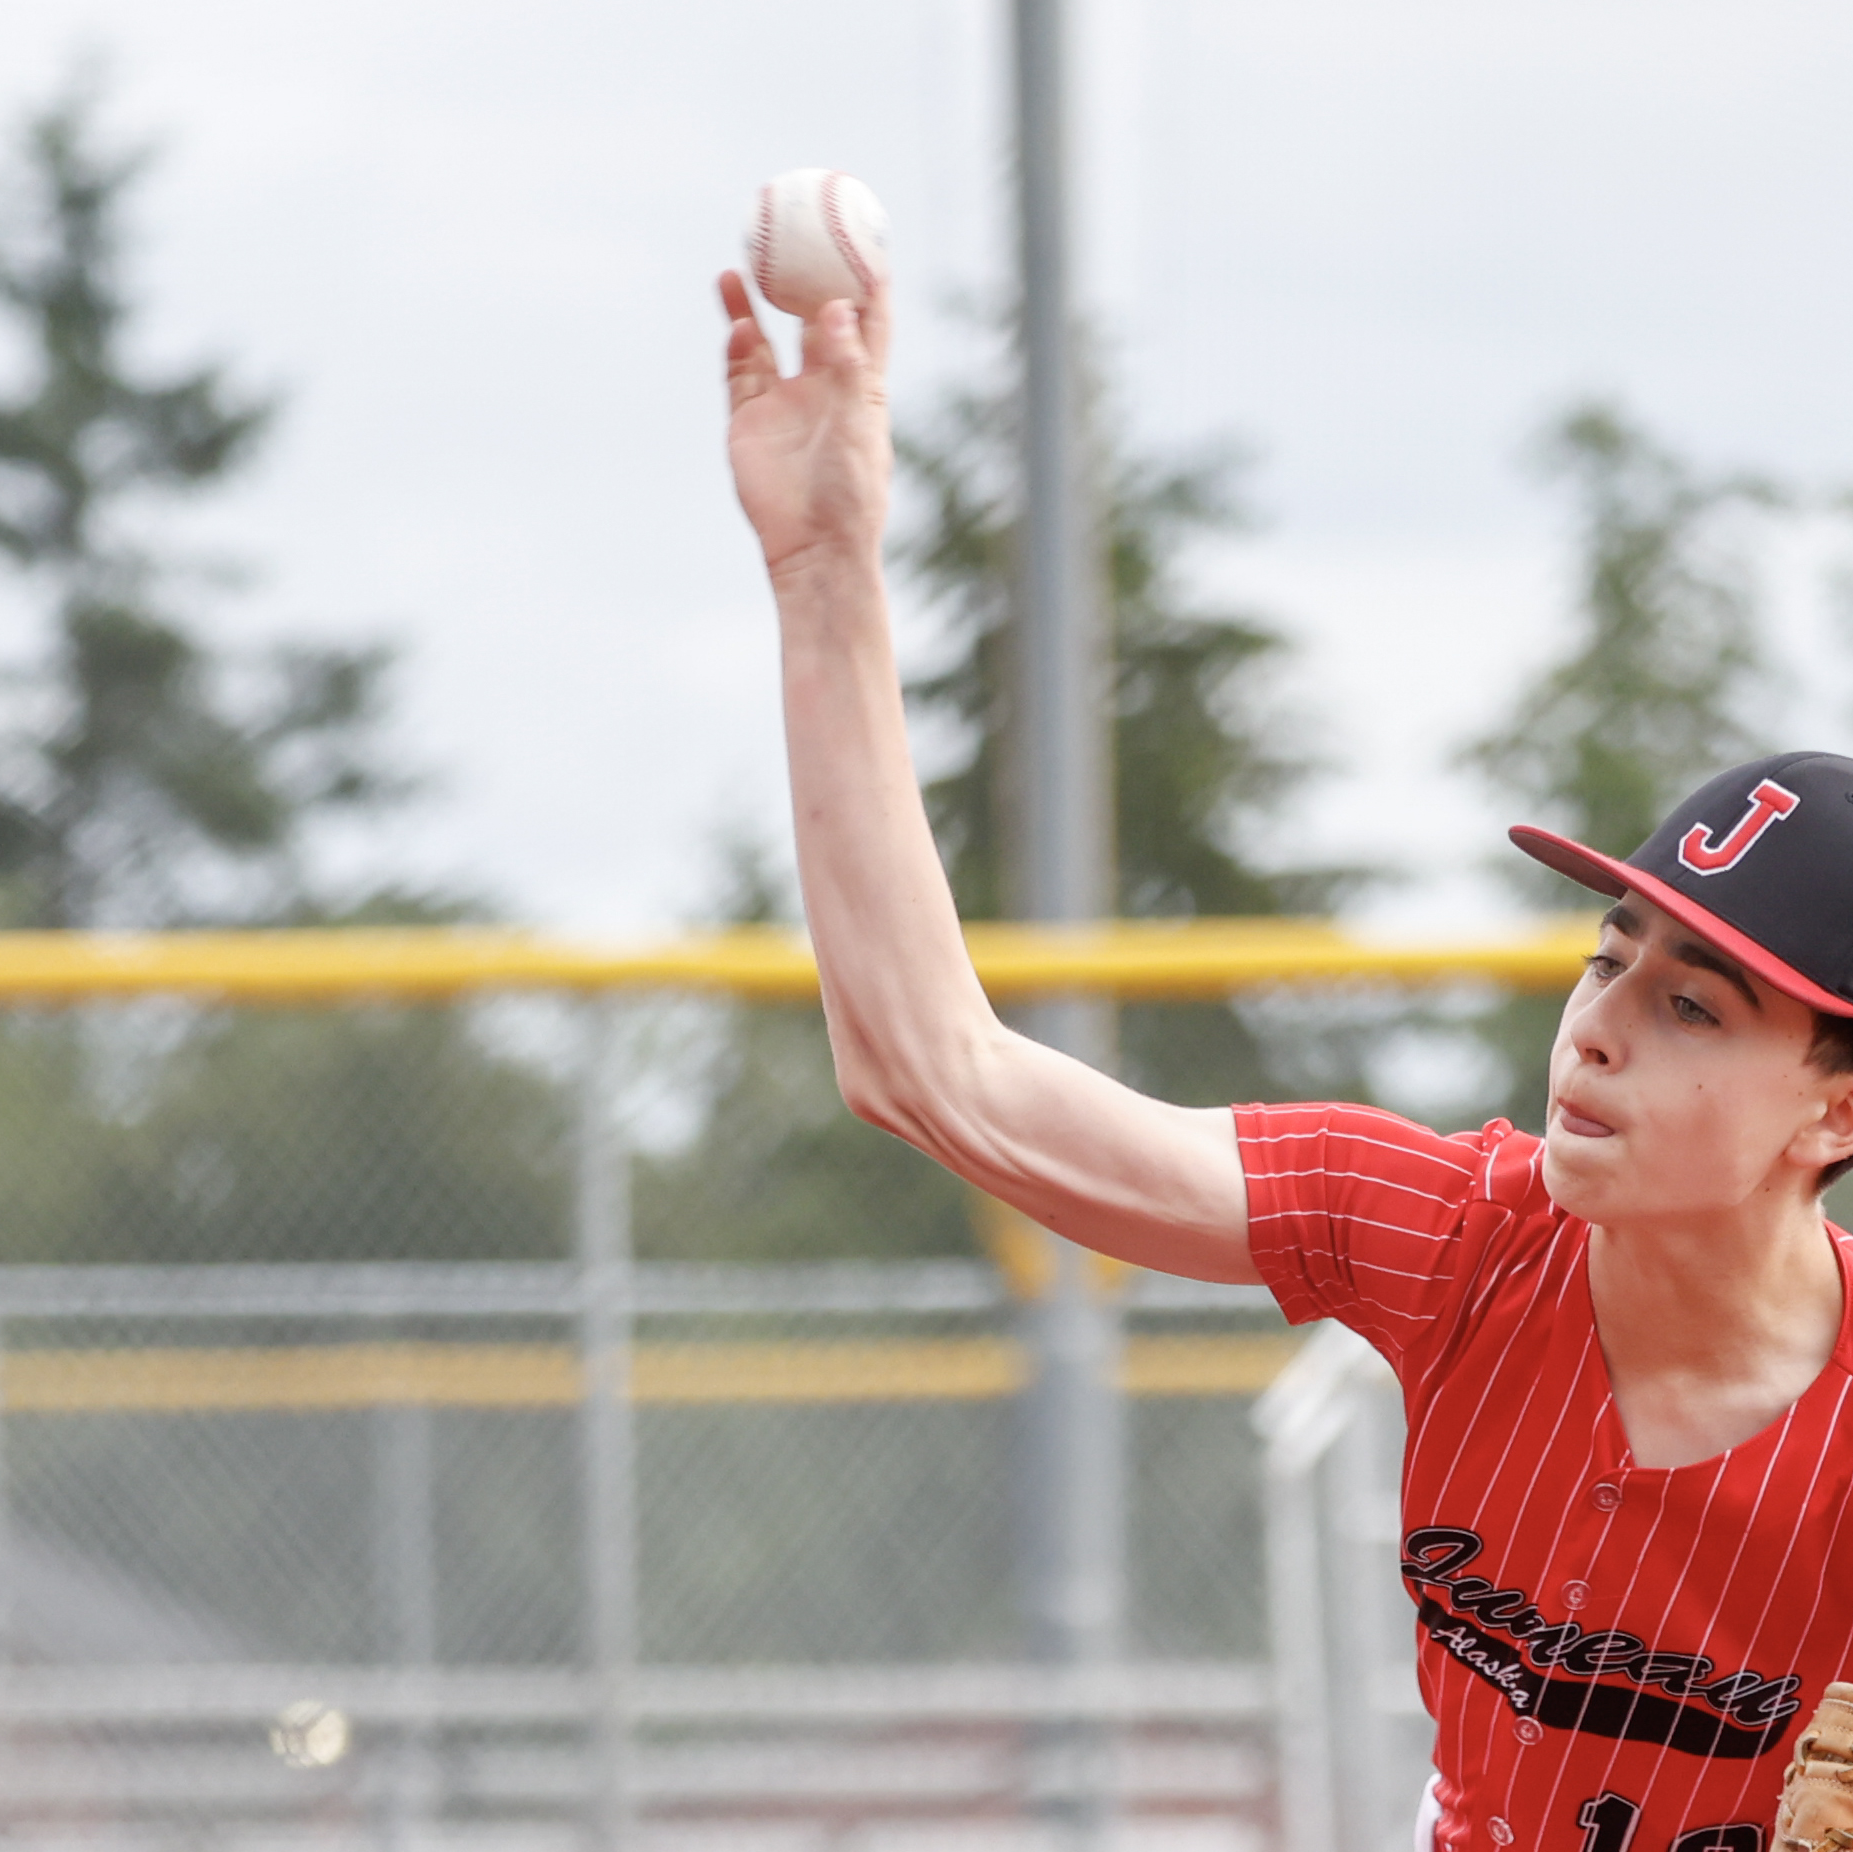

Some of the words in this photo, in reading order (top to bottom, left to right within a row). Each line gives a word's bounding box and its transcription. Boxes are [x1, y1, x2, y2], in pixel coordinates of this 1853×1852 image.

[1678, 778, 1801, 876] J
[1401, 1526, 1801, 1726] Juneau
[1430, 1626, 1530, 1709] Alaska
